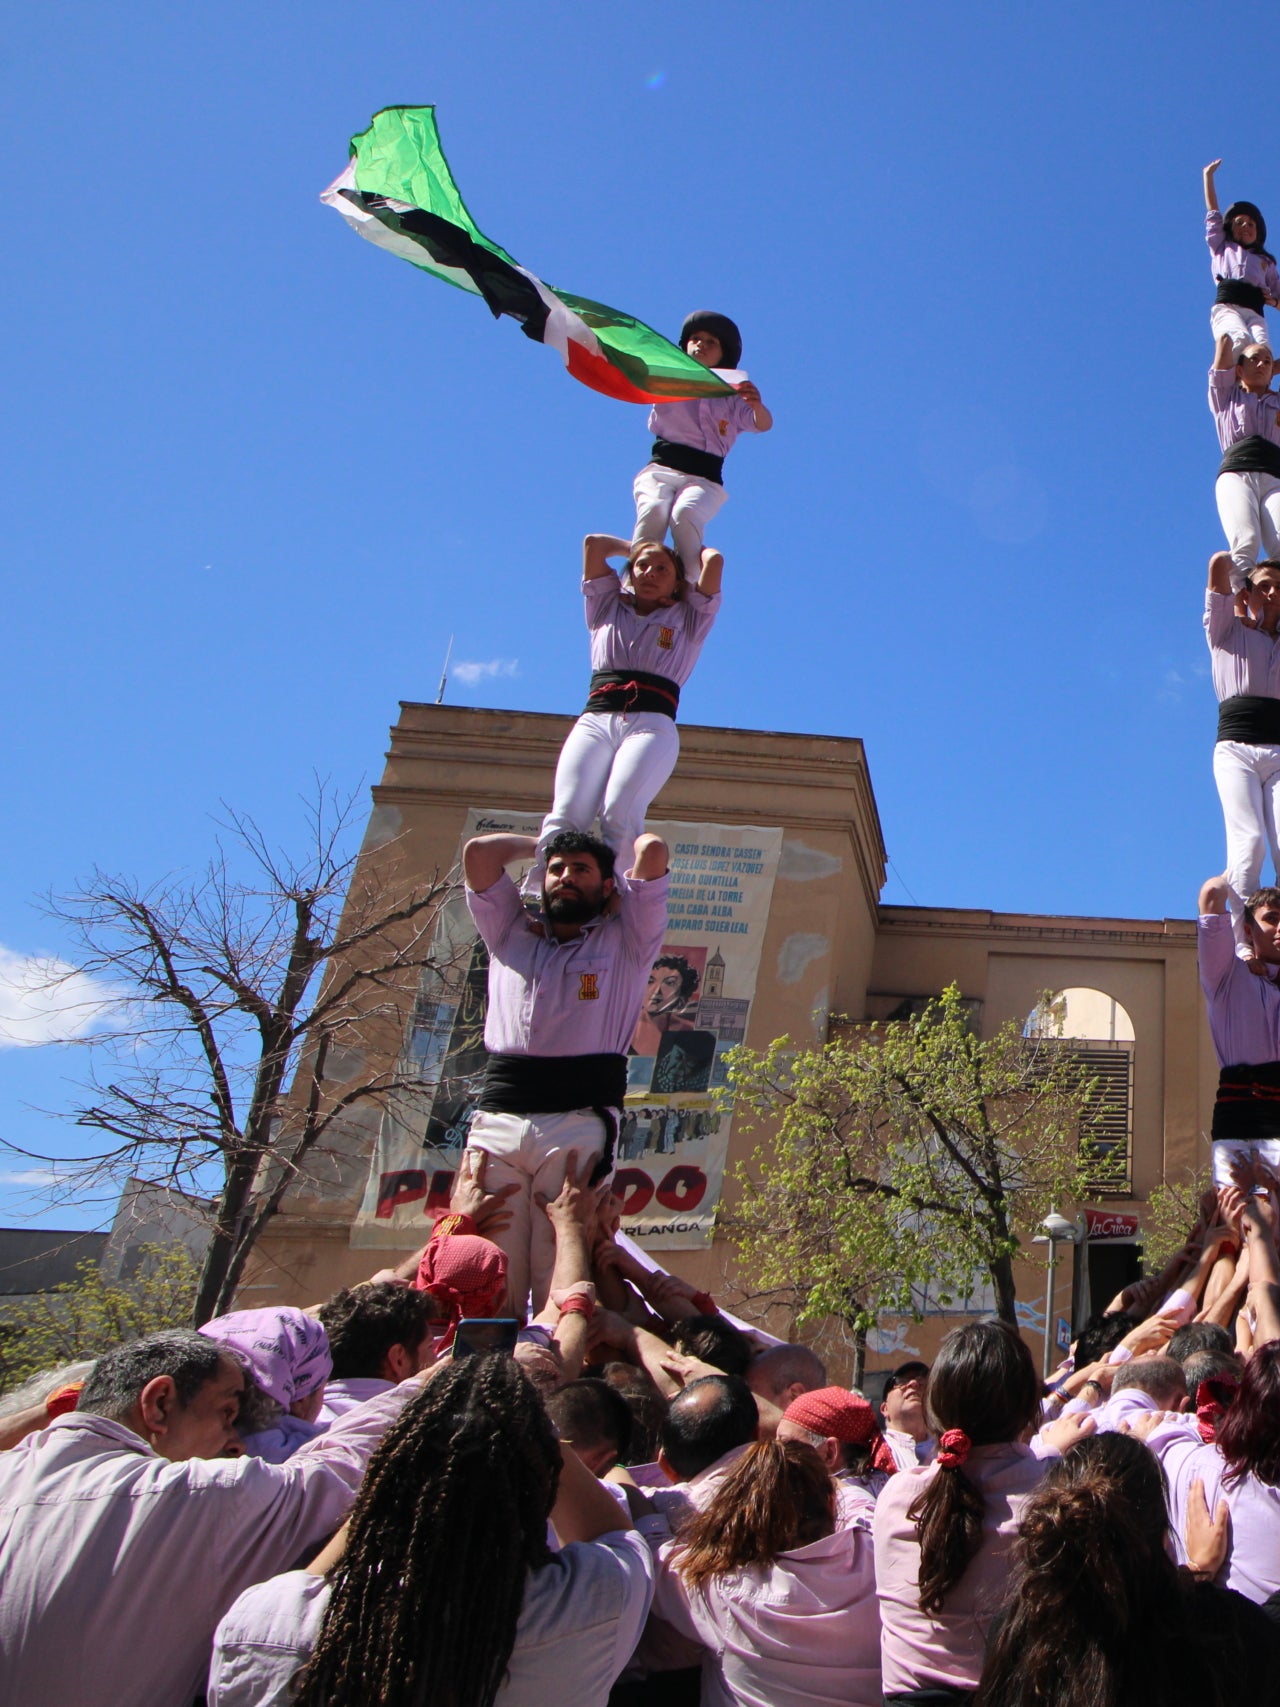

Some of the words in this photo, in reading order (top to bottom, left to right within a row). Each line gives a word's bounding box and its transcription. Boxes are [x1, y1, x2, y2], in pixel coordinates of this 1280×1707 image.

[675, 843, 699, 856] CASTO
[701, 845, 731, 858] SENDRA
[690, 859, 707, 870] LUIS
[709, 860, 731, 872] LOPEZ
[732, 862, 764, 874] VAZQUEZ
[698, 874, 738, 887] QUINTILLA
[696, 889, 705, 900] DE
[707, 890, 715, 901] LA
[719, 890, 743, 903] TORRE
[711, 906, 733, 917] ALBA
[667, 918, 703, 930] AMPARO
[705, 920, 730, 933] SOLER
[730, 922, 748, 934] LEAL
